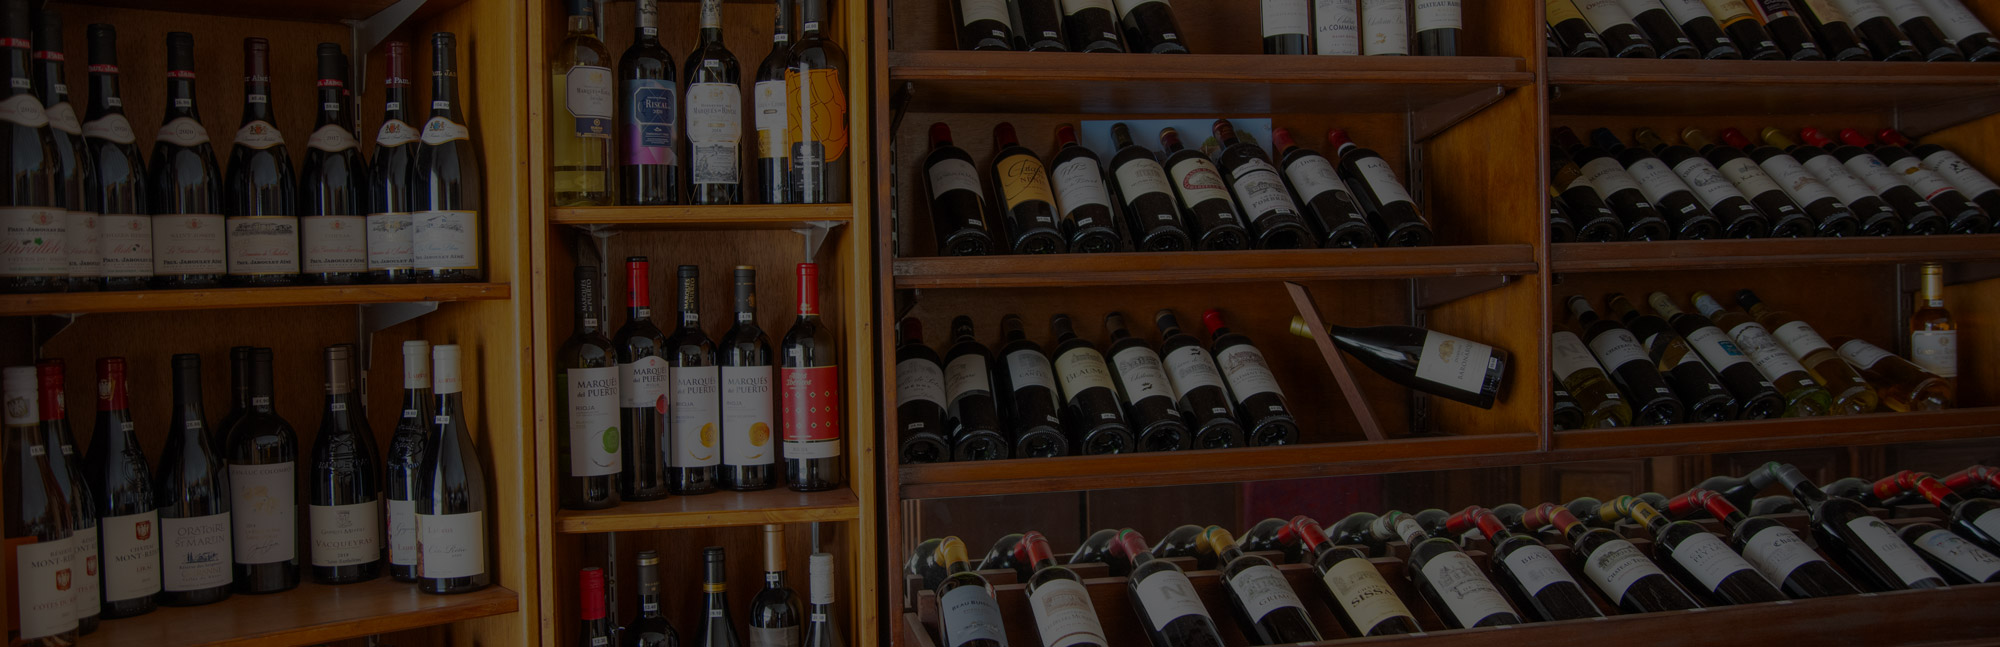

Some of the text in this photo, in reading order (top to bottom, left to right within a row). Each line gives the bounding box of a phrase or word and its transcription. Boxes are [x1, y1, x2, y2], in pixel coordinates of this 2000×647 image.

[646, 99, 668, 109] RISCAL
[728, 376, 768, 385] MARQUÉS
[588, 388, 618, 397] PUERTO
[687, 385, 716, 394] PUERTO
[736, 385, 768, 393] PUERTO
[315, 538, 374, 549] VACQUEYRAS
